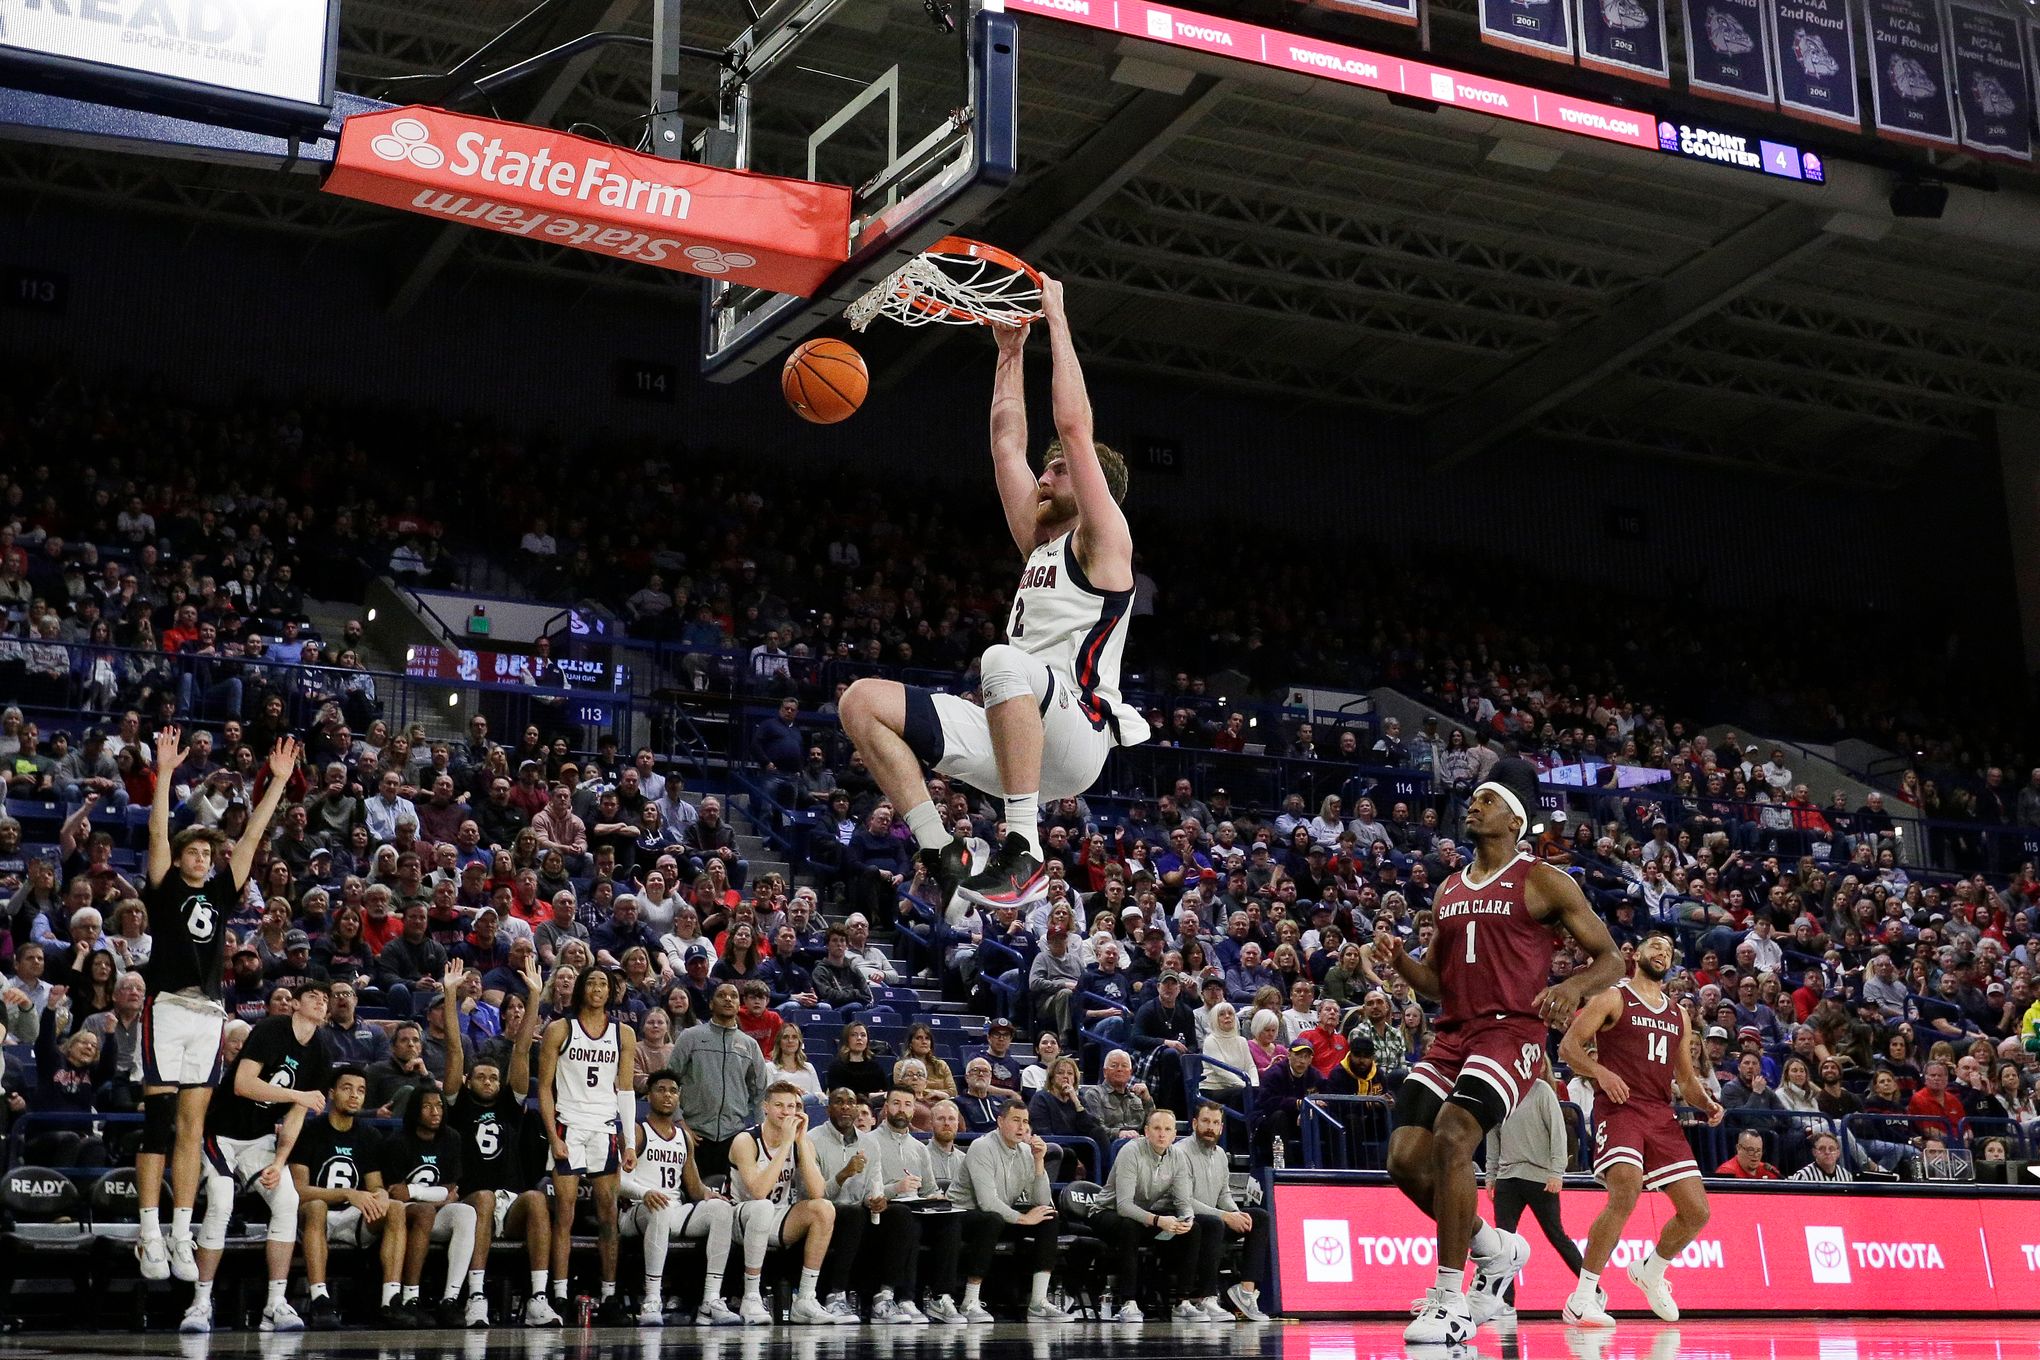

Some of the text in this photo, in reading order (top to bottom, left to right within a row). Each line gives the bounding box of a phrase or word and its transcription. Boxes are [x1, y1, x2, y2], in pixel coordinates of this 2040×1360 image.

[1516, 15, 1537, 28] 2001
[1780, 5, 1844, 31] 2nd Round
[1889, 16, 1921, 34] NCAA
[1175, 22, 1233, 47] TOYOTA
[1901, 35, 1939, 53] Round
[119, 28, 265, 68] SPORTS DRINK
[1289, 46, 1379, 79] TOYOTA.COM
[1456, 84, 1509, 108] TOYOTA
[1558, 107, 1640, 137] TOYOTA.COM
[1680, 125, 1747, 151] 3-POINT
[1681, 139, 1761, 168] COUNTER
[1775, 150, 1788, 170] 4
[19, 277, 56, 303] 113
[635, 370, 667, 393] 114
[1147, 445, 1176, 468] 115
[580, 706, 602, 722] 113
[1396, 782, 1413, 795] 114
[1540, 796, 1558, 809] 115
[2024, 841, 2039, 853] 115
[1439, 900, 1511, 920] SANTA CLARA
[1465, 920, 1477, 964] 1
[1631, 1015, 1657, 1029] SANTA
[568, 1047, 617, 1064] GONZAGA
[1647, 1033, 1668, 1065] 14
[586, 1066, 600, 1088] 5
[475, 1122, 500, 1155] 6
[11, 1178, 65, 1195] READY
[104, 1181, 138, 1196] REA
[659, 1166, 676, 1189] 13
[1852, 1242, 1945, 1269] TOYOTA
